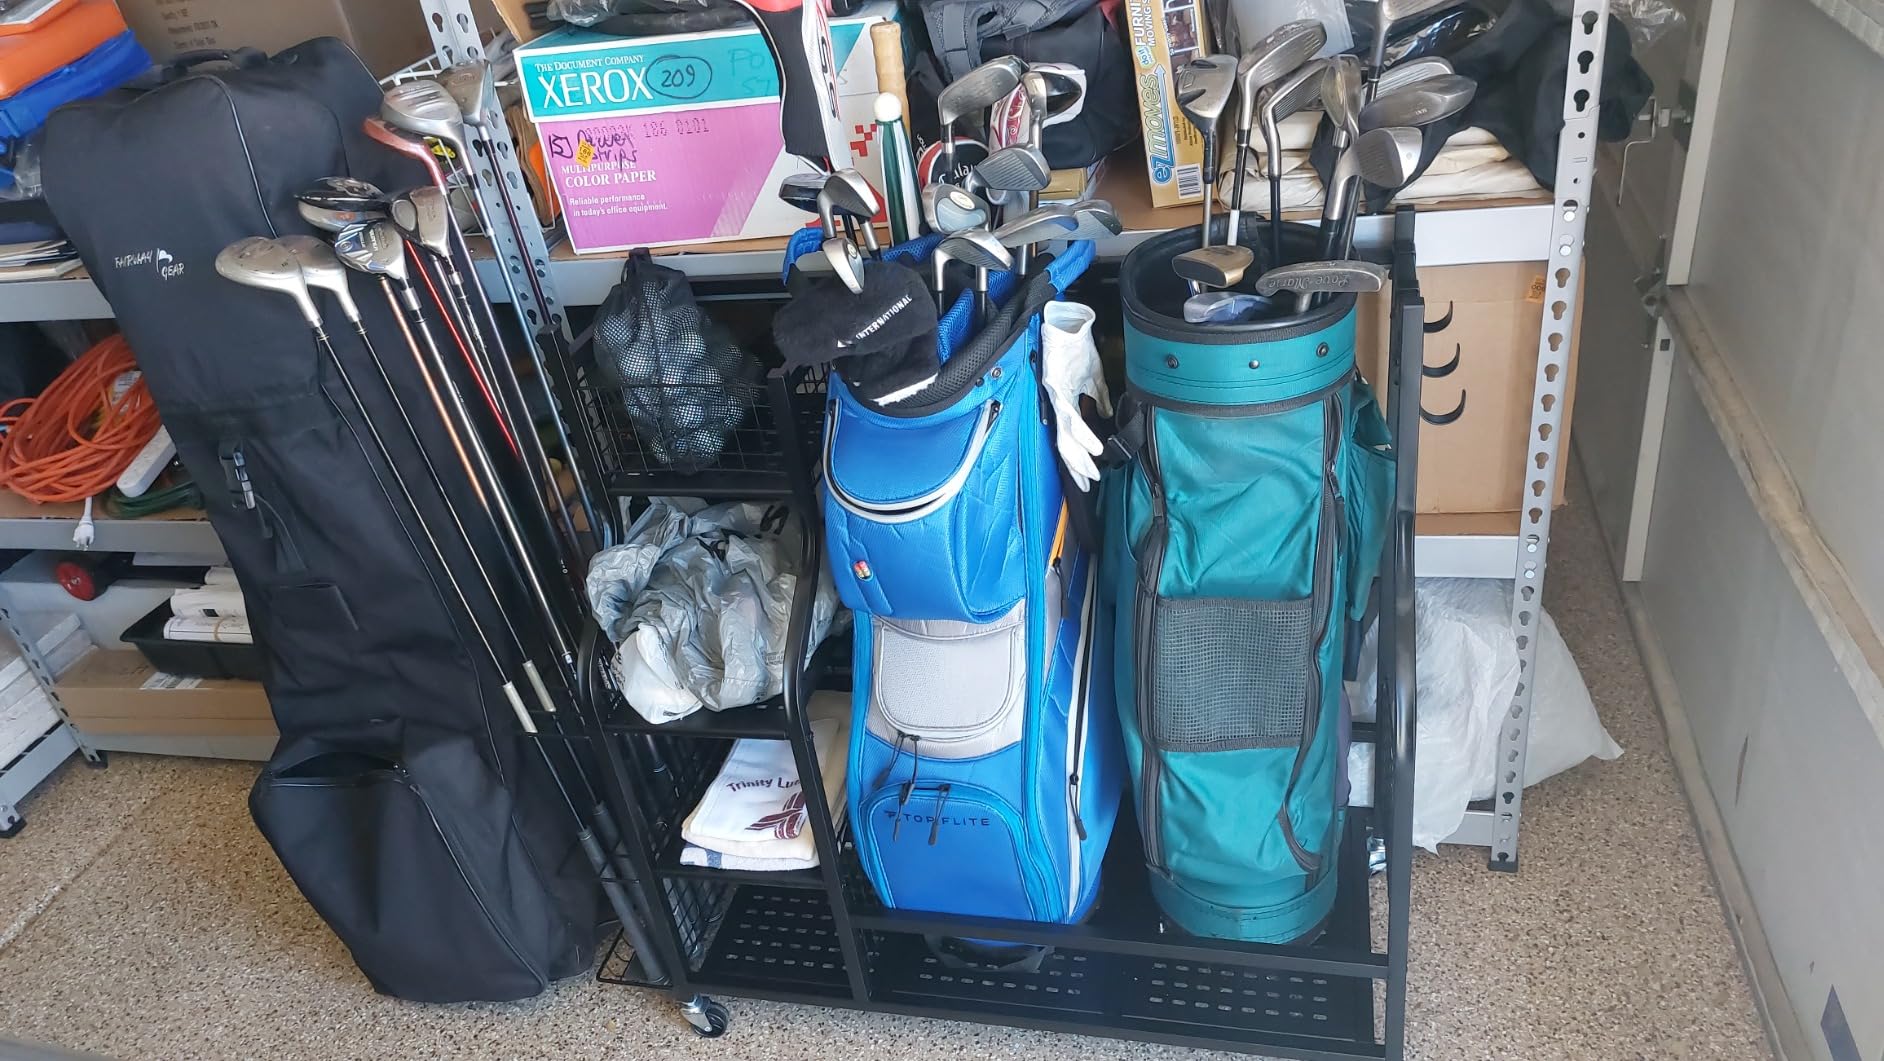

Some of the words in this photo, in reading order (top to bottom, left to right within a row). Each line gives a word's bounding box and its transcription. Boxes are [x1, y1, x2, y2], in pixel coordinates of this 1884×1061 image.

[1143, 6, 1155, 47] MOVING
[535, 63, 553, 73] THE
[554, 57, 602, 71] DOCUMENT
[604, 54, 645, 66] COMPANY
[661, 63, 696, 88] 209
[538, 66, 654, 110] XEROX
[565, 173, 610, 188] COLOR
[614, 169, 657, 184] PAPER
[569, 196, 599, 206] Reliable
[600, 193, 645, 206] performance
[573, 209, 581, 217] in
[581, 207, 606, 218] today's
[606, 203, 627, 214] office
[114, 249, 153, 268] FAIRWAY
[161, 262, 185, 280] GEAR
[855, 294, 913, 340] INTERNATIONAL
[726, 778, 773, 792] Trinity
[941, 817, 991, 826] FLITE
